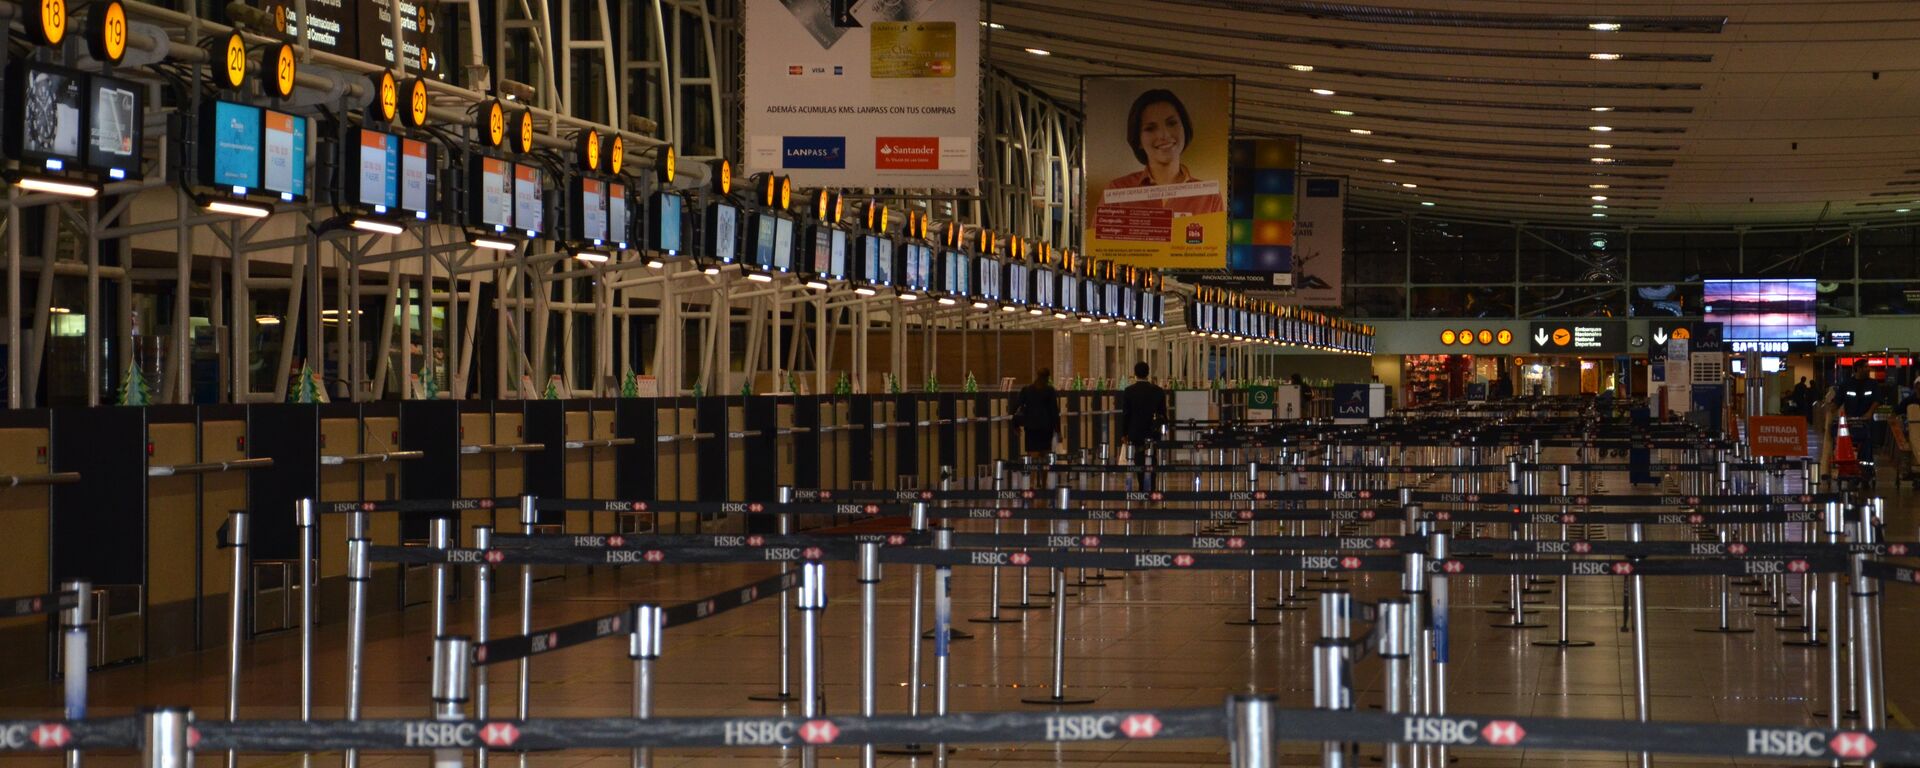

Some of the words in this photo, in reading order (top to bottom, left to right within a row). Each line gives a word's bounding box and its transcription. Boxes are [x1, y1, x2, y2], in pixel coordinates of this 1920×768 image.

[45, 0, 61, 28] 18
[109, 17, 122, 46] 19
[312, 28, 336, 46] Connections
[231, 47, 243, 72] 20
[281, 57, 291, 82] 21
[384, 84, 394, 107] 22
[414, 91, 424, 114] 23
[766, 105, 797, 114] ADEMÁS
[798, 106, 837, 114] ACUMULAS
[857, 106, 888, 114] LANPASS
[787, 148, 827, 157] LANPASS
[892, 145, 935, 154] Santander
[1732, 342, 1789, 352] SAMSUNG
[1339, 405, 1365, 414] LAN
[1760, 425, 1797, 434] ENTRADA
[1758, 436, 1800, 444] ENTRANCE
[795, 489, 818, 499] HSBC
[896, 491, 919, 500] HSBC
[998, 490, 1021, 499] HSBC
[1126, 491, 1149, 500] HSBC
[1230, 491, 1252, 500] HSBC
[1333, 490, 1357, 499] HSBC
[1772, 495, 1797, 504] HSBC
[452, 500, 478, 509] HSBC
[605, 501, 631, 511] HSBC
[721, 502, 748, 512] HSBC
[837, 503, 863, 513] HSBC
[969, 509, 996, 518] HSBC
[1088, 510, 1114, 519] HSBC
[1210, 510, 1237, 519] HSBC
[1331, 510, 1358, 519] HSBC
[1531, 513, 1559, 523] HSBC
[1658, 514, 1686, 523] HSBC
[1786, 511, 1815, 521] HSBC
[574, 536, 605, 547] HSBC
[714, 536, 745, 547] HSBC
[1047, 536, 1079, 547] HSBC
[1192, 537, 1225, 548] HSBC
[1340, 538, 1373, 549] HSBC
[1536, 542, 1569, 553] HSBC
[1690, 543, 1725, 554] HSBC
[447, 550, 482, 563] HSBC
[606, 551, 641, 562] HSBC
[765, 548, 800, 560] HSBC
[971, 552, 1008, 564] HSBC
[1135, 554, 1172, 566] HSBC
[1302, 556, 1338, 568] HSBC
[1571, 562, 1609, 574] HSBC
[1745, 560, 1784, 573] HSBC
[725, 720, 794, 746] HSBC
[1046, 716, 1115, 741] HSBC
[1403, 717, 1478, 745] HSBC
[405, 722, 474, 747] HSBC
[1746, 728, 1825, 757] HSBC
